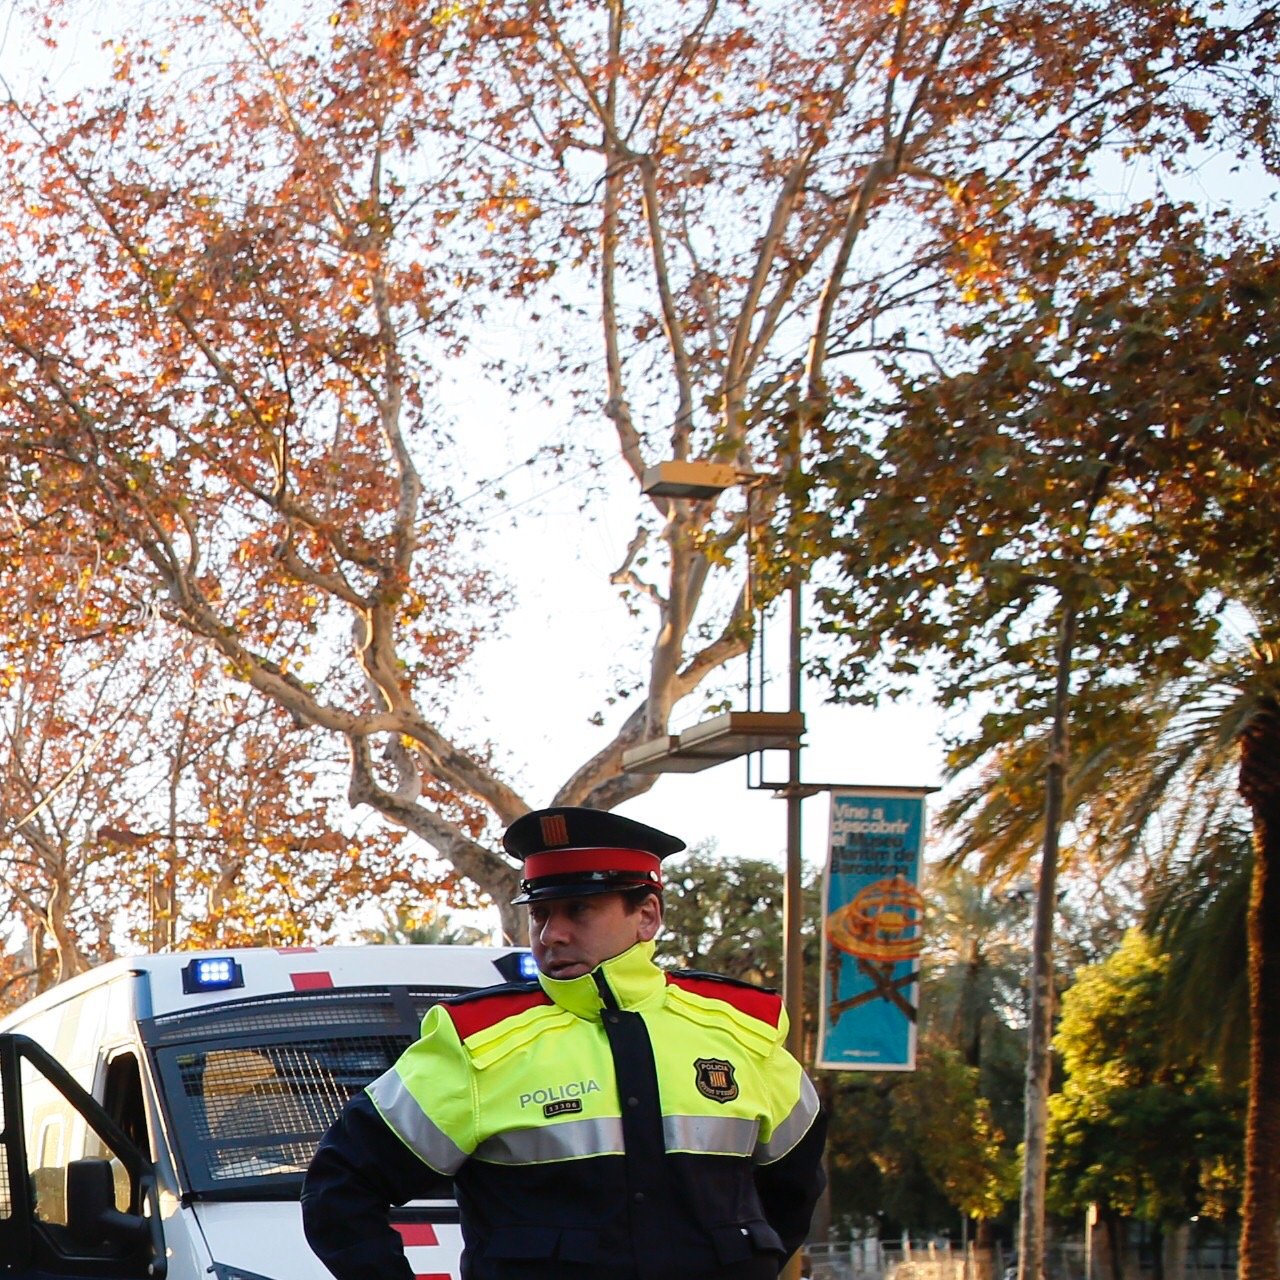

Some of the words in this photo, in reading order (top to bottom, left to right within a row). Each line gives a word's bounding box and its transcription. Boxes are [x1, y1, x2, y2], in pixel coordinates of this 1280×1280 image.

[833, 803, 870, 818] Vine
[873, 808, 884, 818] a
[832, 819, 910, 833] descobrir
[895, 849, 915, 861] de
[701, 1063, 729, 1072] POLICIA
[519, 1079, 601, 1109] POLICIA
